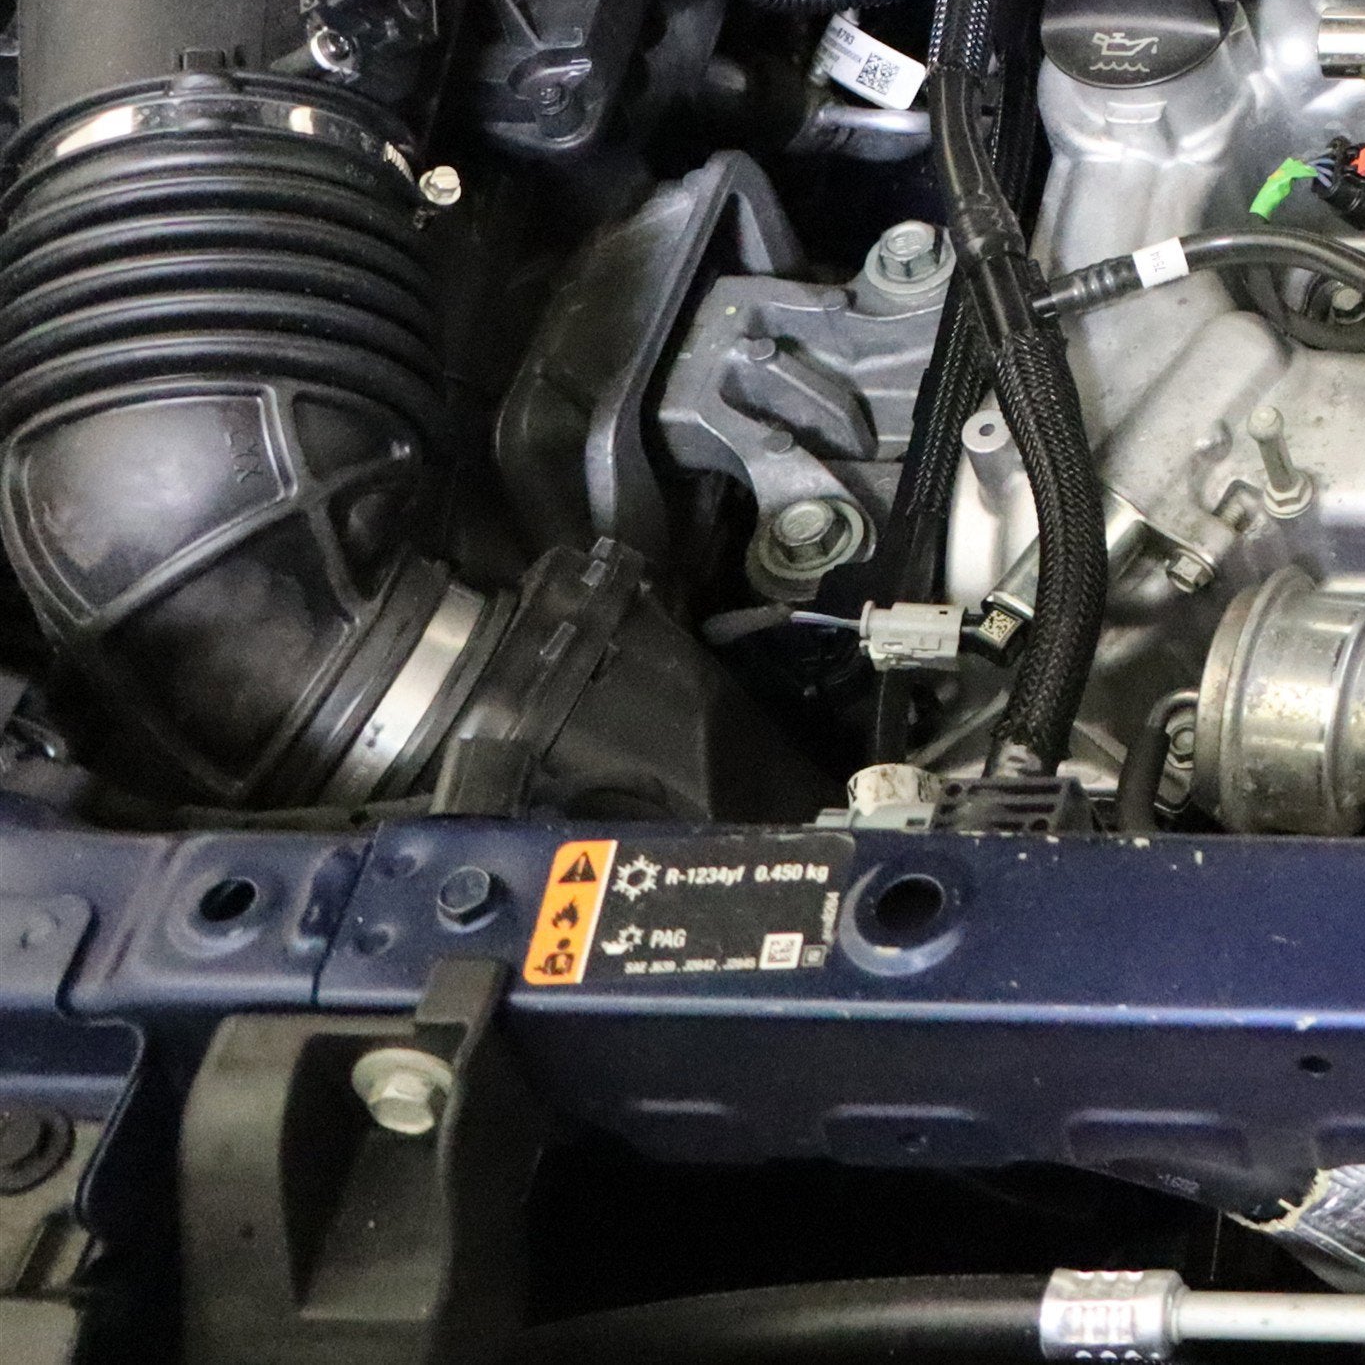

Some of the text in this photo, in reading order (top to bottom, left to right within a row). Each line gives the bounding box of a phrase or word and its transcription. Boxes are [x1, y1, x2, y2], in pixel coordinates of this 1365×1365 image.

[664, 863, 830, 887] R-1234yf 0.450 kg
[650, 929, 688, 949] PAG
